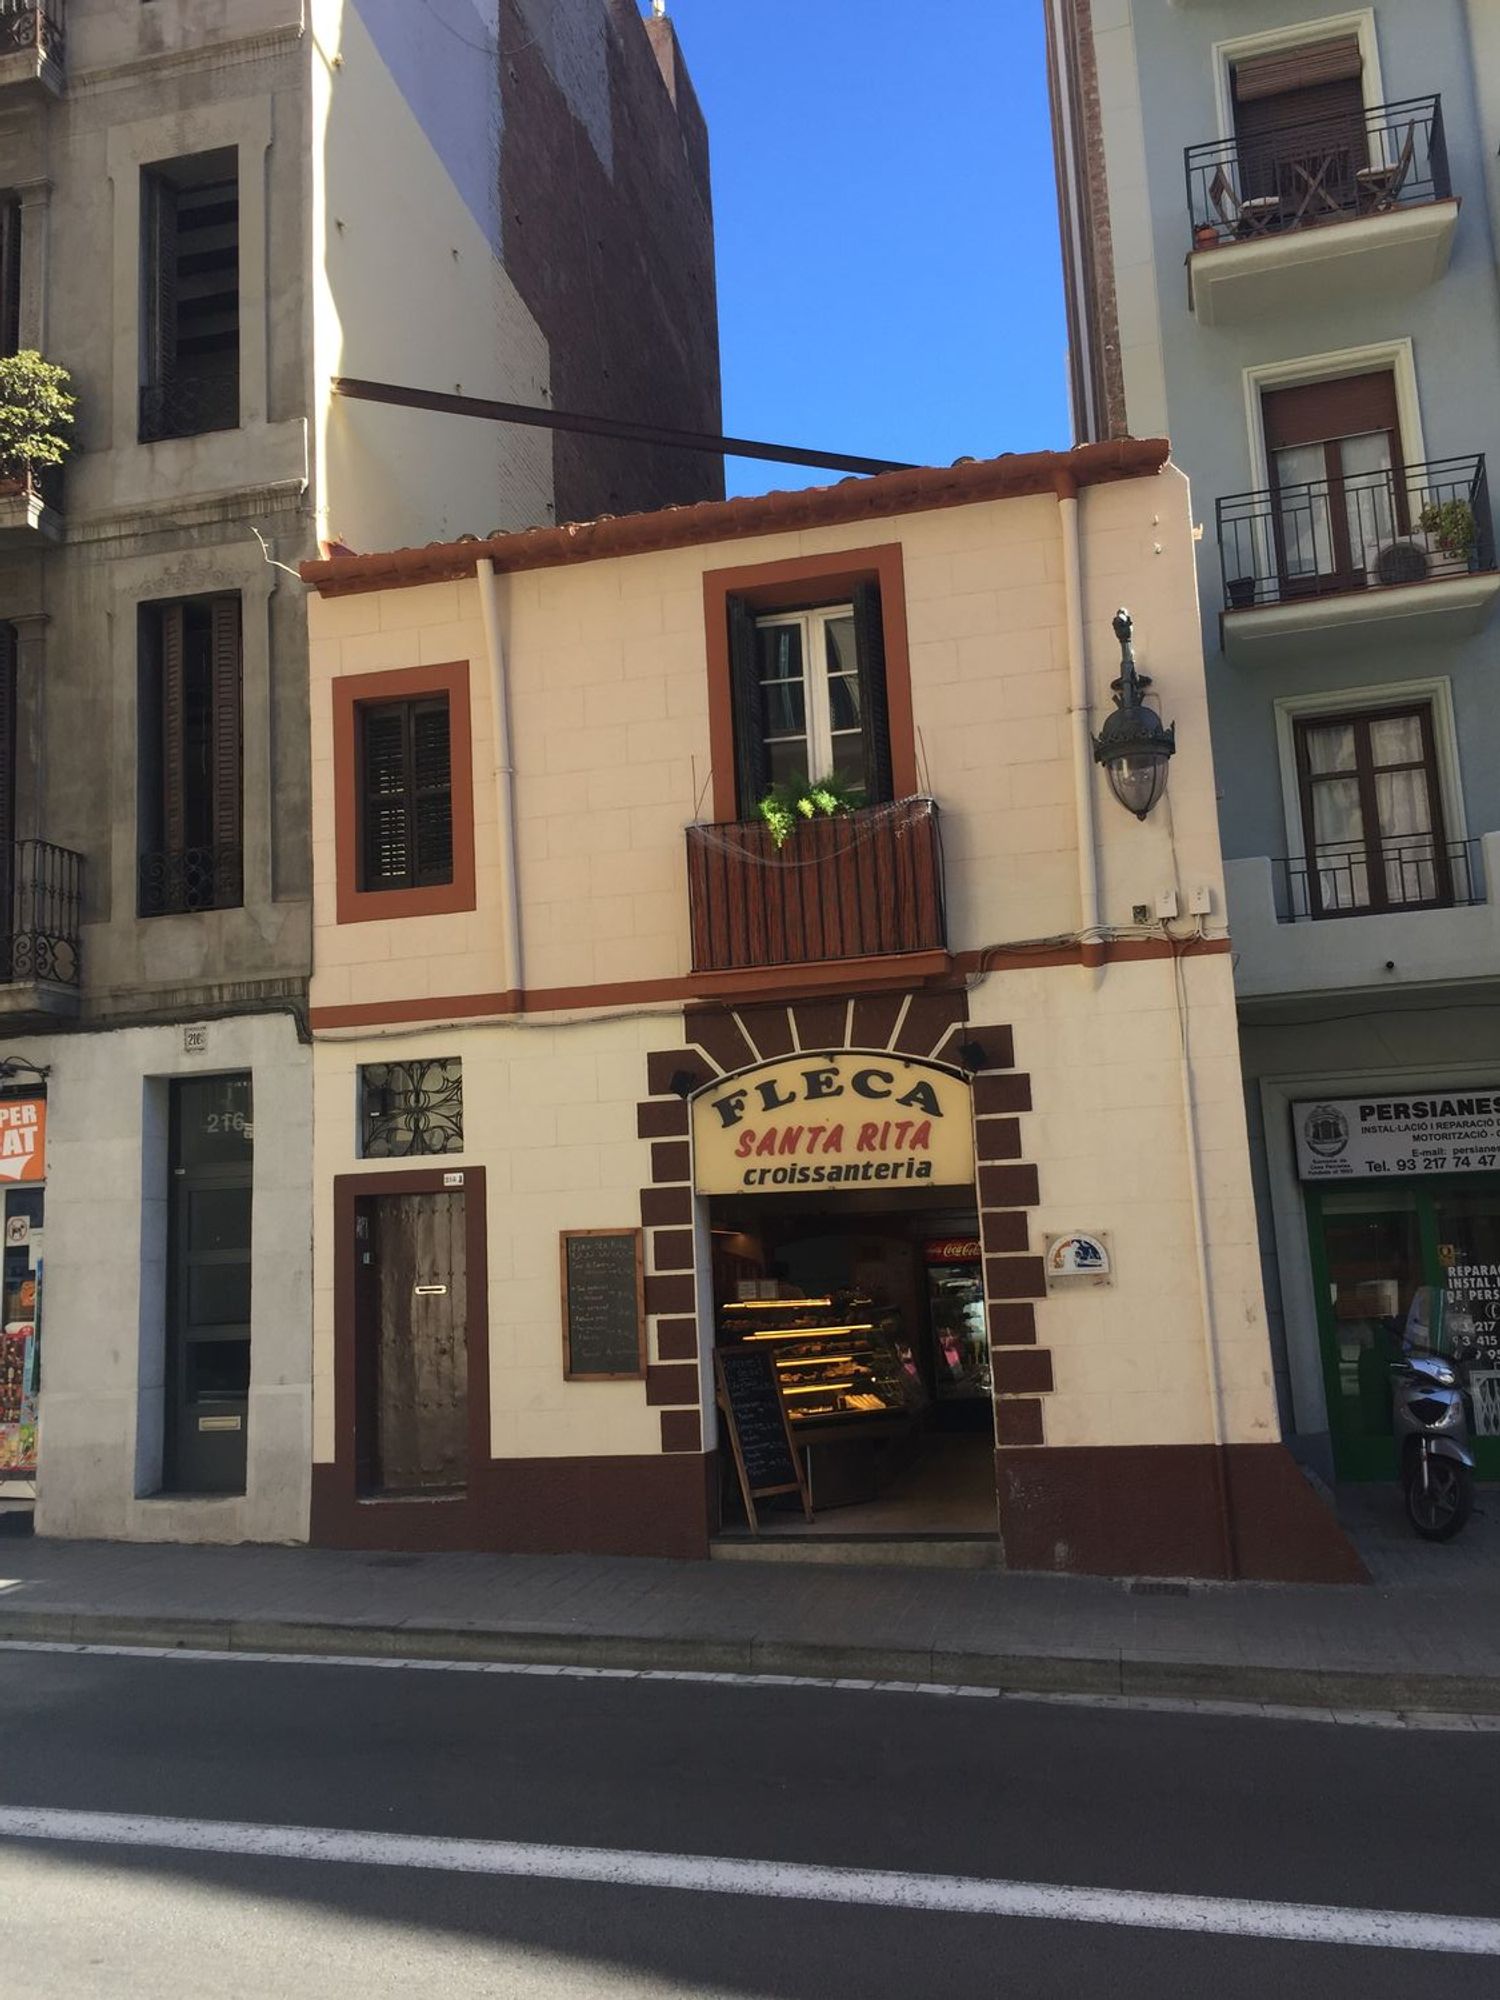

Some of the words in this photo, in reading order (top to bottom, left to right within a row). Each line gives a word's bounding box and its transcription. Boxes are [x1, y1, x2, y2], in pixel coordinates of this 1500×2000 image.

[712, 1067, 943, 1129] FLECA
[207, 1112, 245, 1133] 216
[735, 1124, 844, 1158] SANTA
[857, 1120, 932, 1152] RITA
[1412, 1147, 1447, 1158] E-mail:
[743, 1158, 932, 1186] croissanteria
[1365, 1160, 1390, 1172] Tel.
[1396, 1159, 1417, 1171] 93
[1423, 1157, 1447, 1169] 217
[1453, 1156, 1471, 1168] 74
[1478, 1154, 1496, 1167] 47
[1475, 1321, 1496, 1332] 217
[1476, 1335, 1497, 1346] 415
